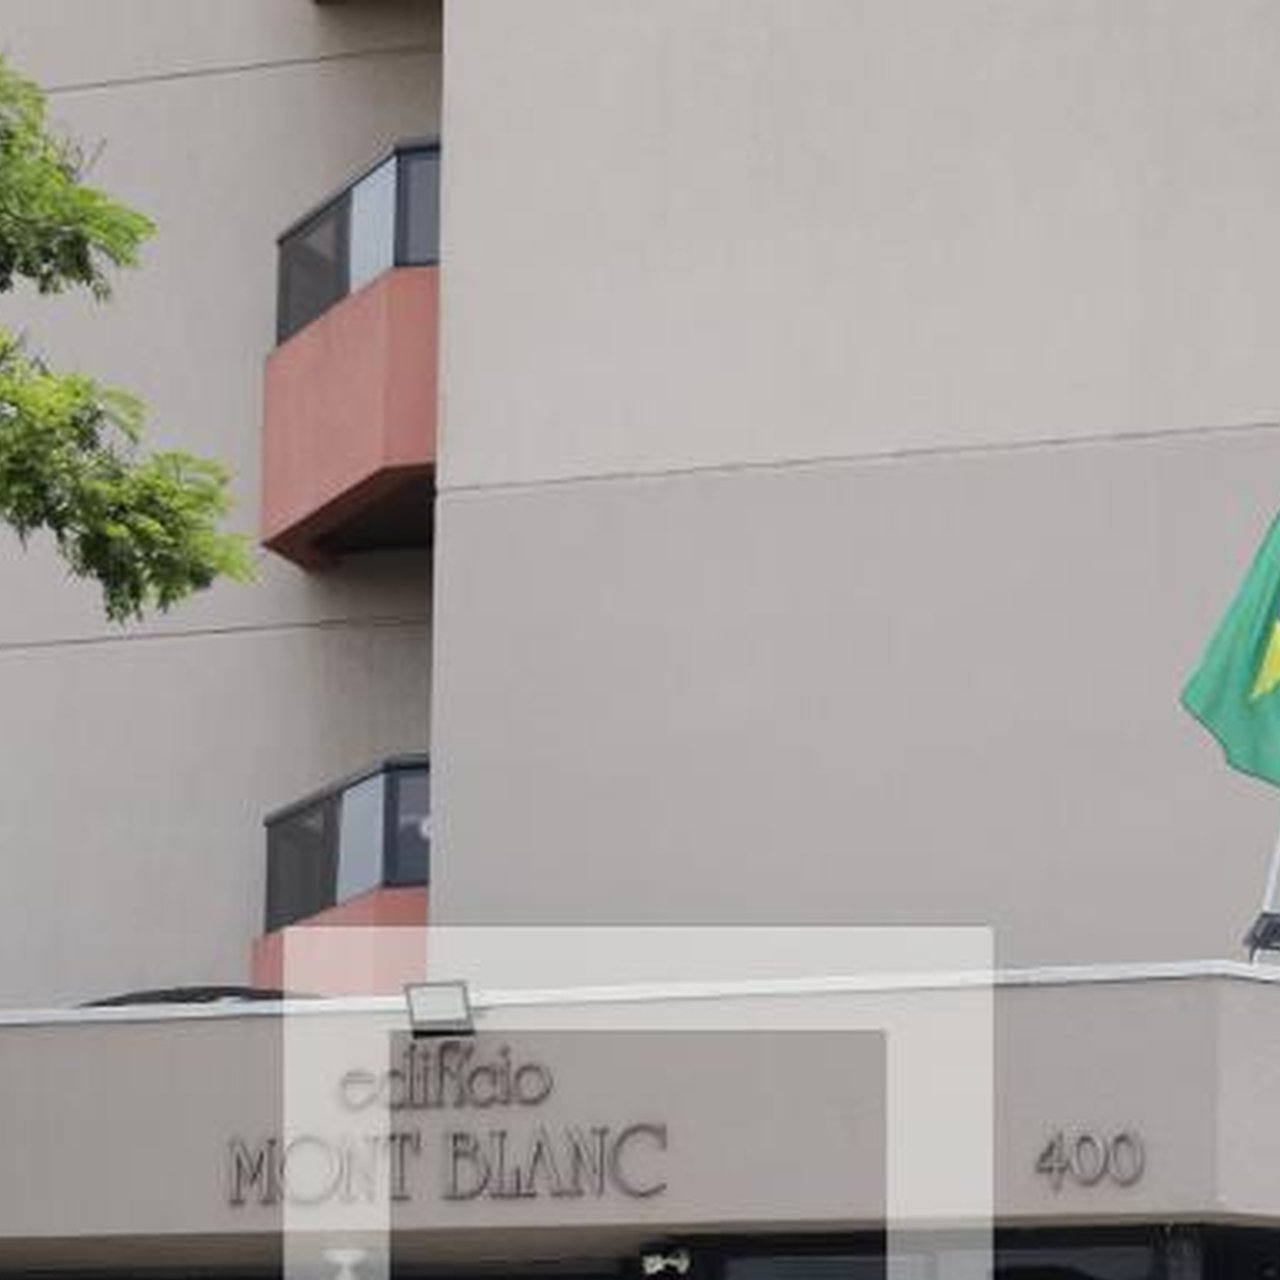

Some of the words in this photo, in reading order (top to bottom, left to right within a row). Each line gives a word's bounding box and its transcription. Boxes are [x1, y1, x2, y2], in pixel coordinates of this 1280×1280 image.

[228, 1132, 422, 1207] MONT
[442, 1122, 669, 1202] BLANC
[1033, 1129, 1147, 1192] 400
